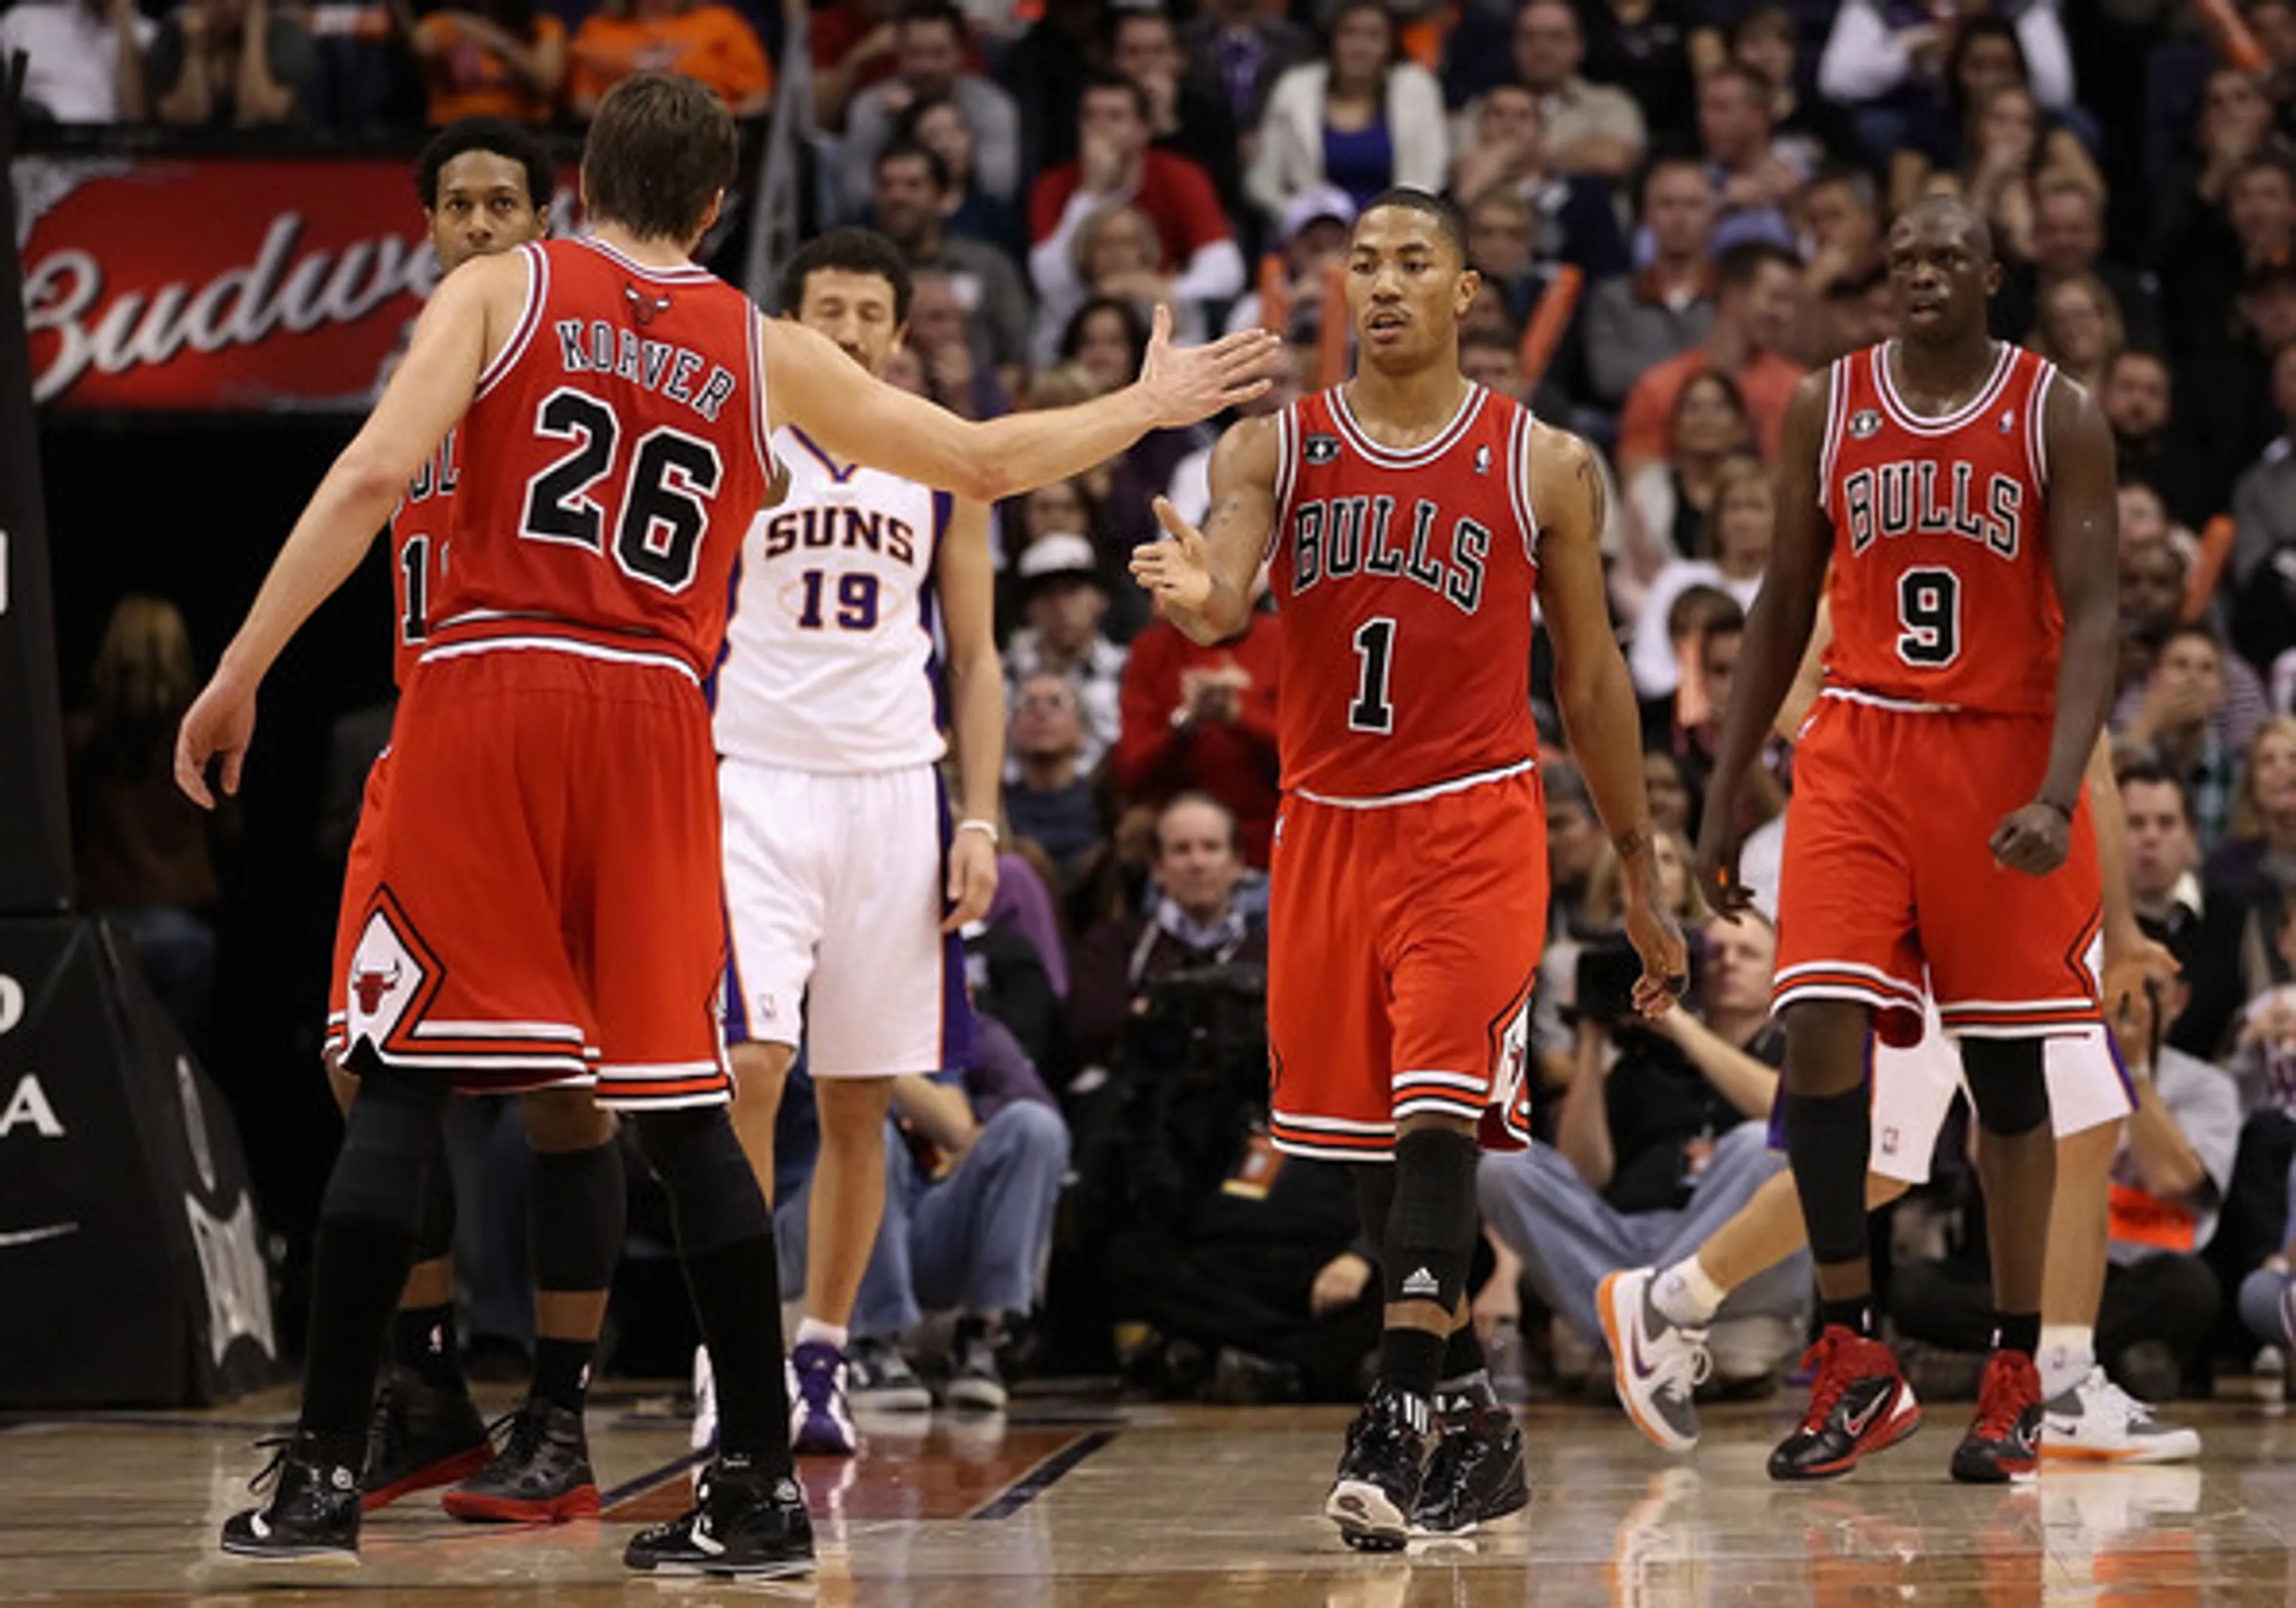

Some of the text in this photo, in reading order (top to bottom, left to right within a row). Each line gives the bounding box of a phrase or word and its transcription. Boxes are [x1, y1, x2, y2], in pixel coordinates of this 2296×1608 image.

[556, 319, 735, 422] KORVER
[518, 386, 723, 594] 26
[765, 506, 914, 567] SUNS
[1844, 460, 2022, 560] BULLS
[401, 533, 450, 645] 1
[798, 569, 881, 632] 19
[1292, 495, 1491, 615] BULLS
[1897, 566, 1961, 668] 9
[1348, 617, 1396, 736] 1
